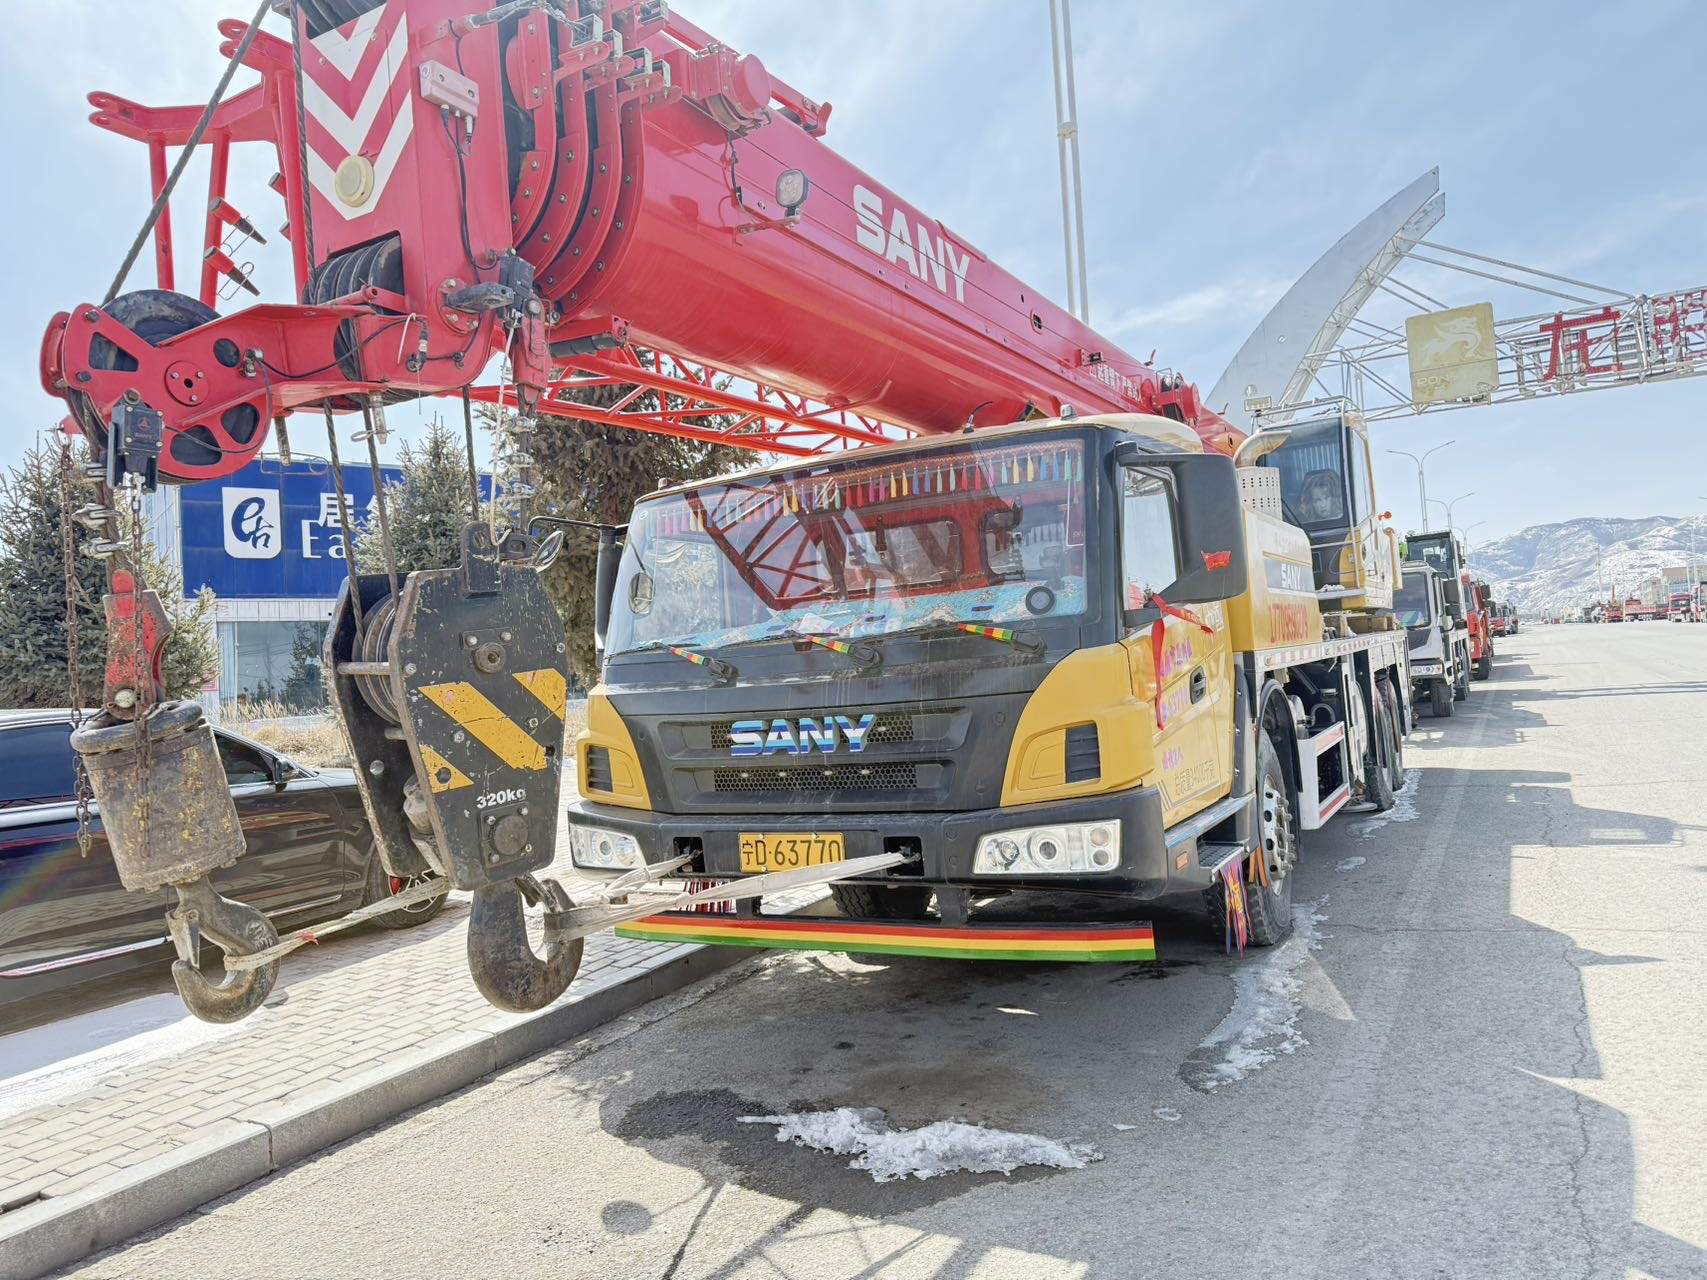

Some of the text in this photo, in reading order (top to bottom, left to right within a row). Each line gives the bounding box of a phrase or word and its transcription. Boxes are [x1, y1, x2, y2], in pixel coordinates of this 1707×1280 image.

[853, 184, 970, 303] SANY
[302, 519, 350, 559] Ea
[730, 713, 877, 756] SANY
